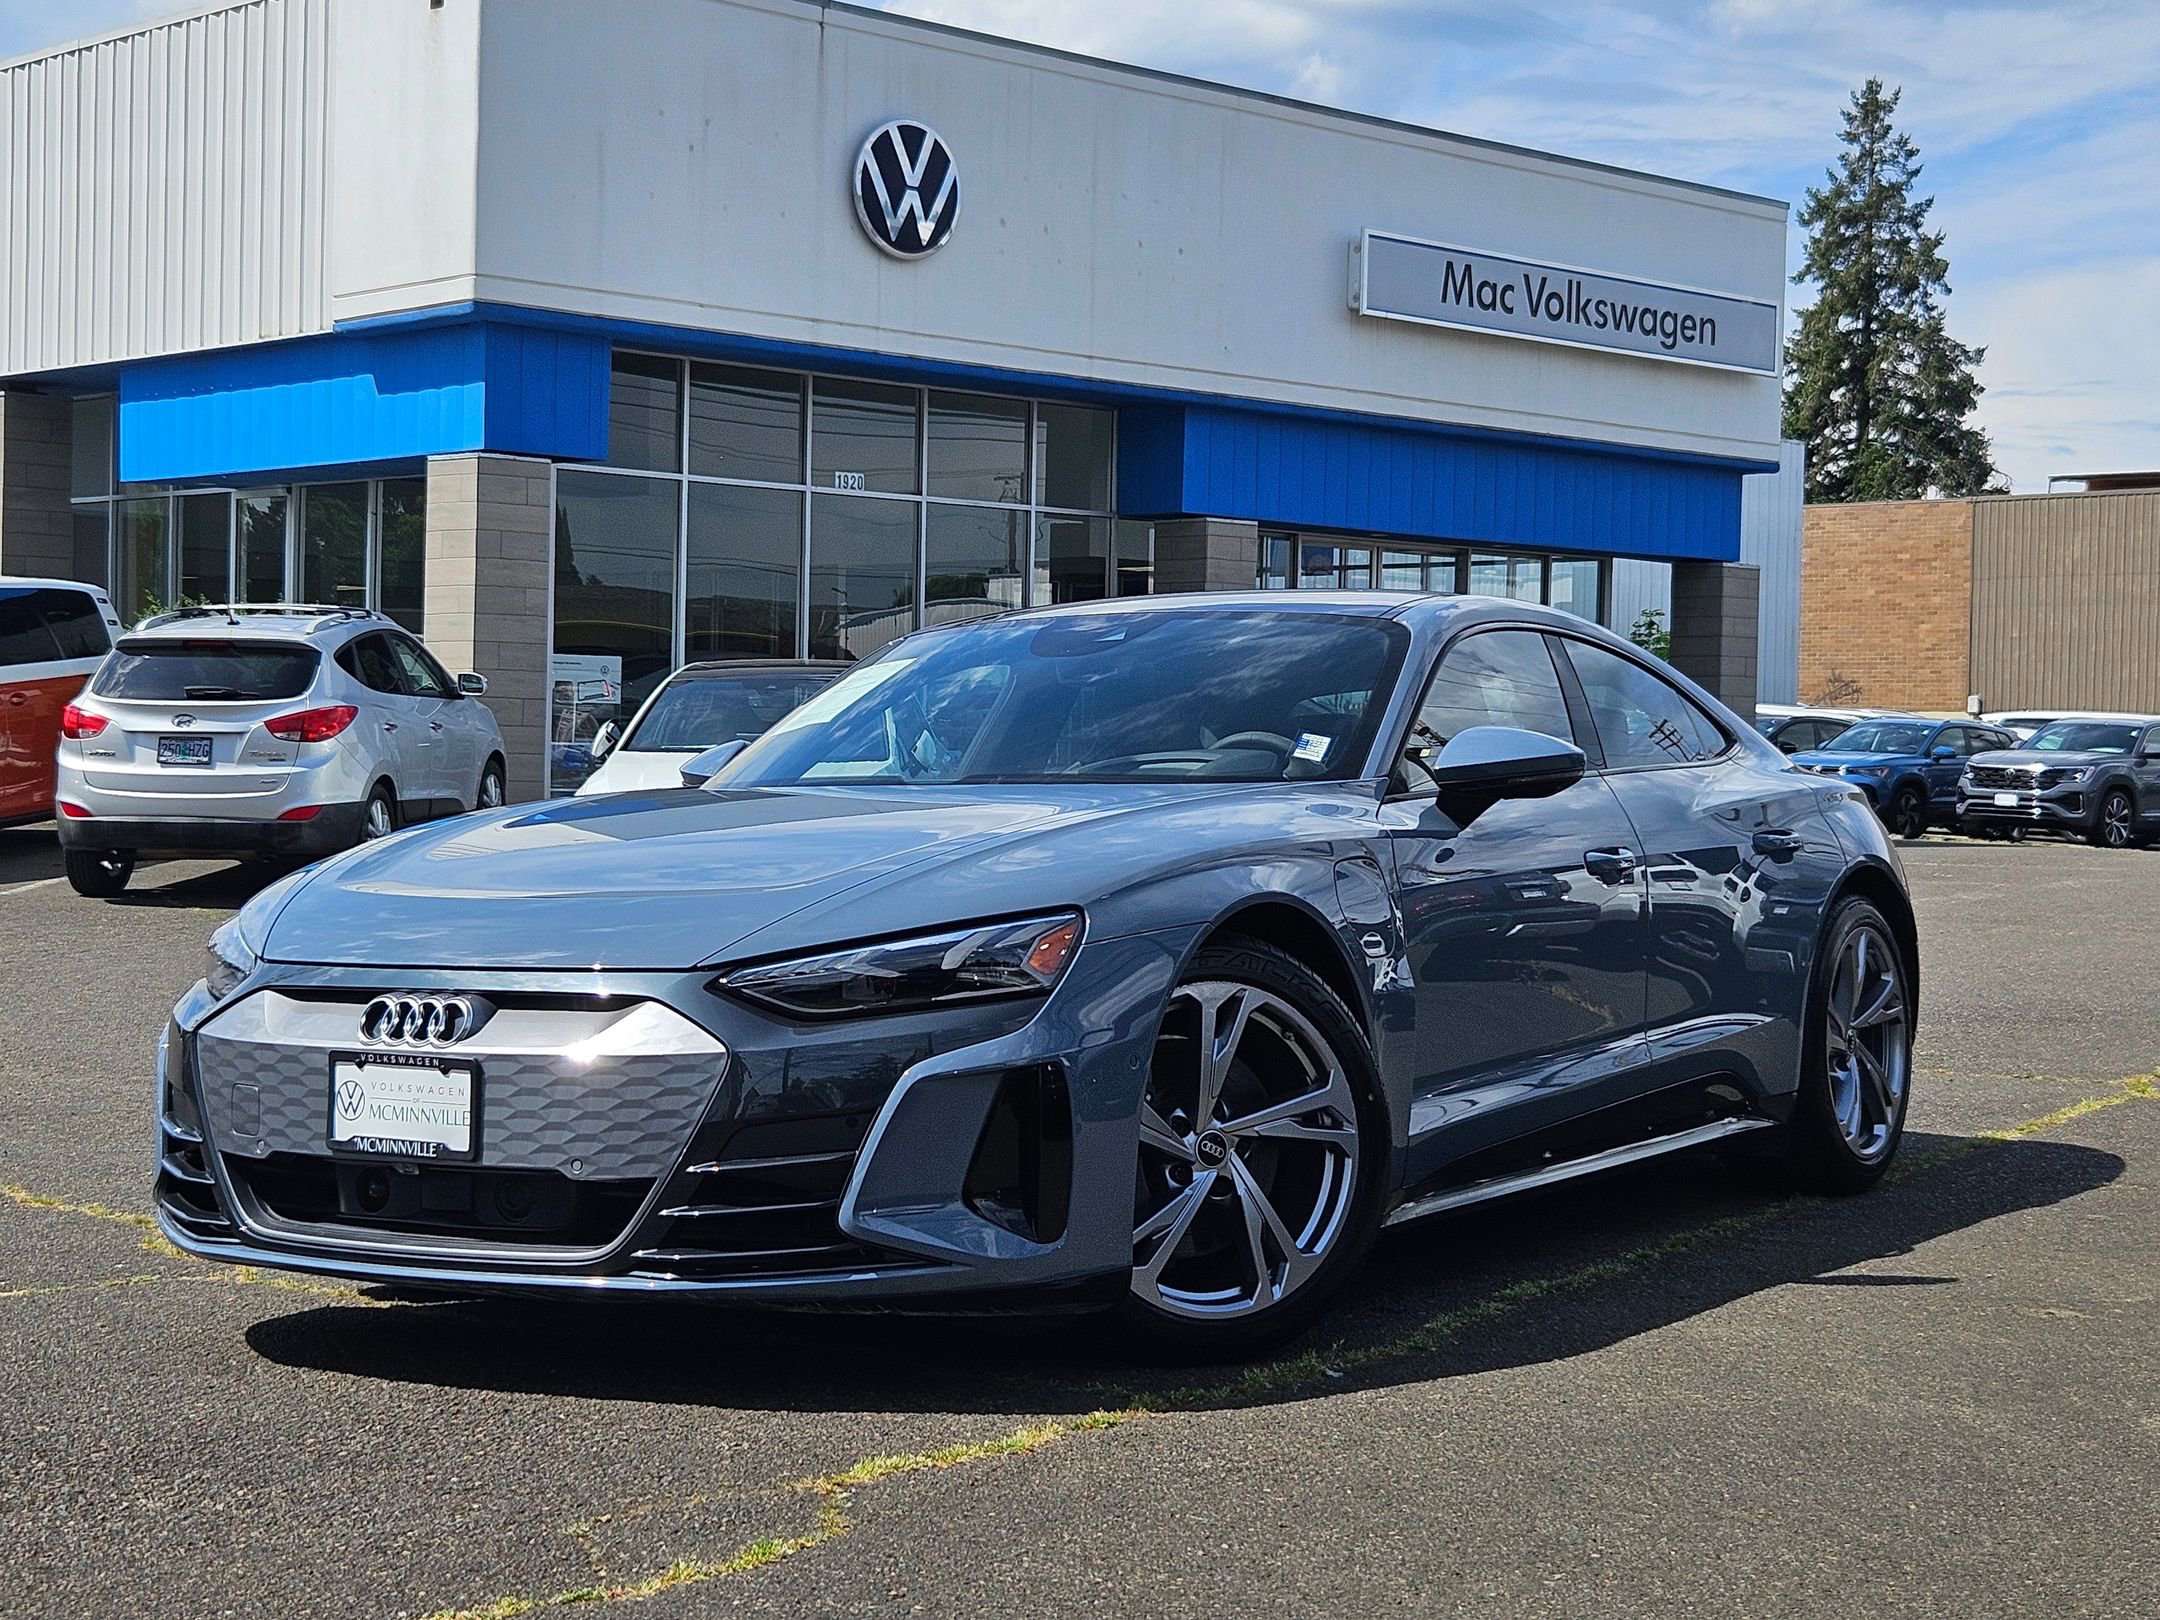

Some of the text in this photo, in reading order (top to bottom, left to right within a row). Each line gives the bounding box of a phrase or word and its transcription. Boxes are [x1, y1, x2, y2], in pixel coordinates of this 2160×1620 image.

[1440, 260, 1717, 350] Mac Volkswagen
[836, 474, 864, 490] 1920
[160, 743, 181, 758] 250
[360, 1053, 439, 1066] VOLKSWAGEN
[371, 1081, 465, 1097] VOLKSWAGEN
[369, 1103, 471, 1127] MCMINNVILLE
[356, 1136, 438, 1158] MCMINNVILLE
